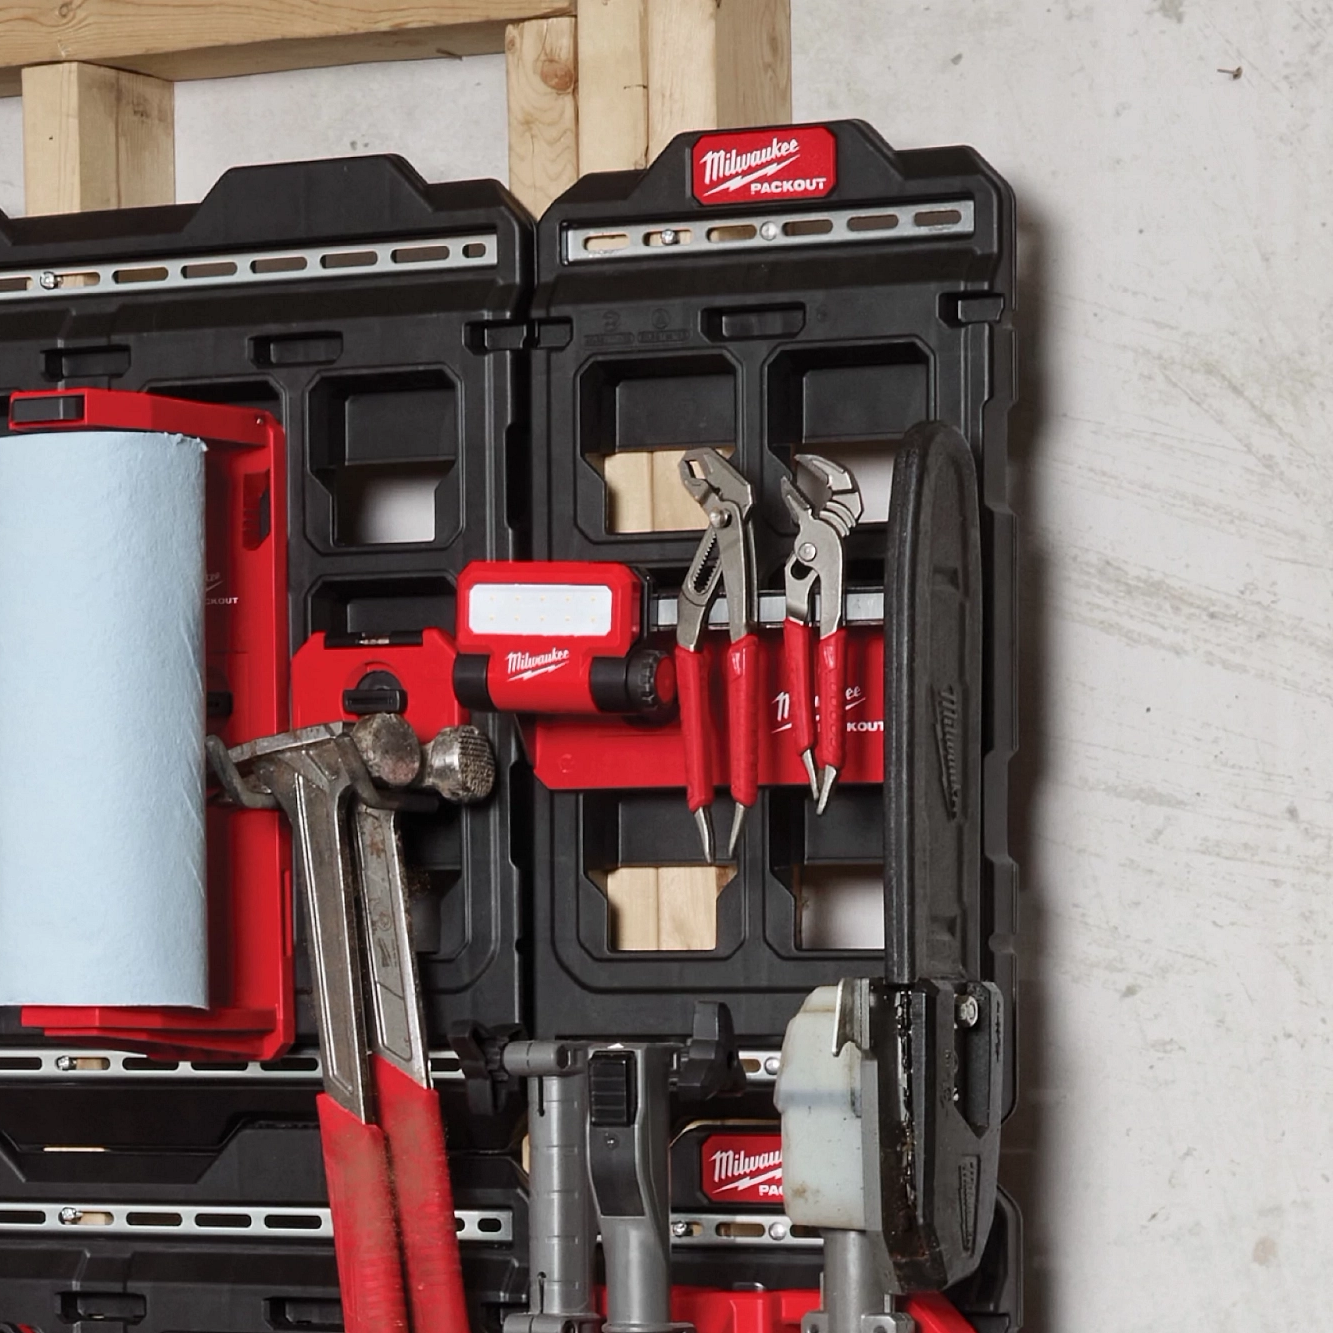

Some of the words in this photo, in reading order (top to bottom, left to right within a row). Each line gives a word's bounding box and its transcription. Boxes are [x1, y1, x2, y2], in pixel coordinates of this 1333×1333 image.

[700, 137, 800, 185] Milwaukee
[750, 177, 827, 194] PACKOUT
[505, 646, 570, 675] Milwaukee
[846, 720, 884, 732] KOUT
[709, 1149, 783, 1183] Milwau
